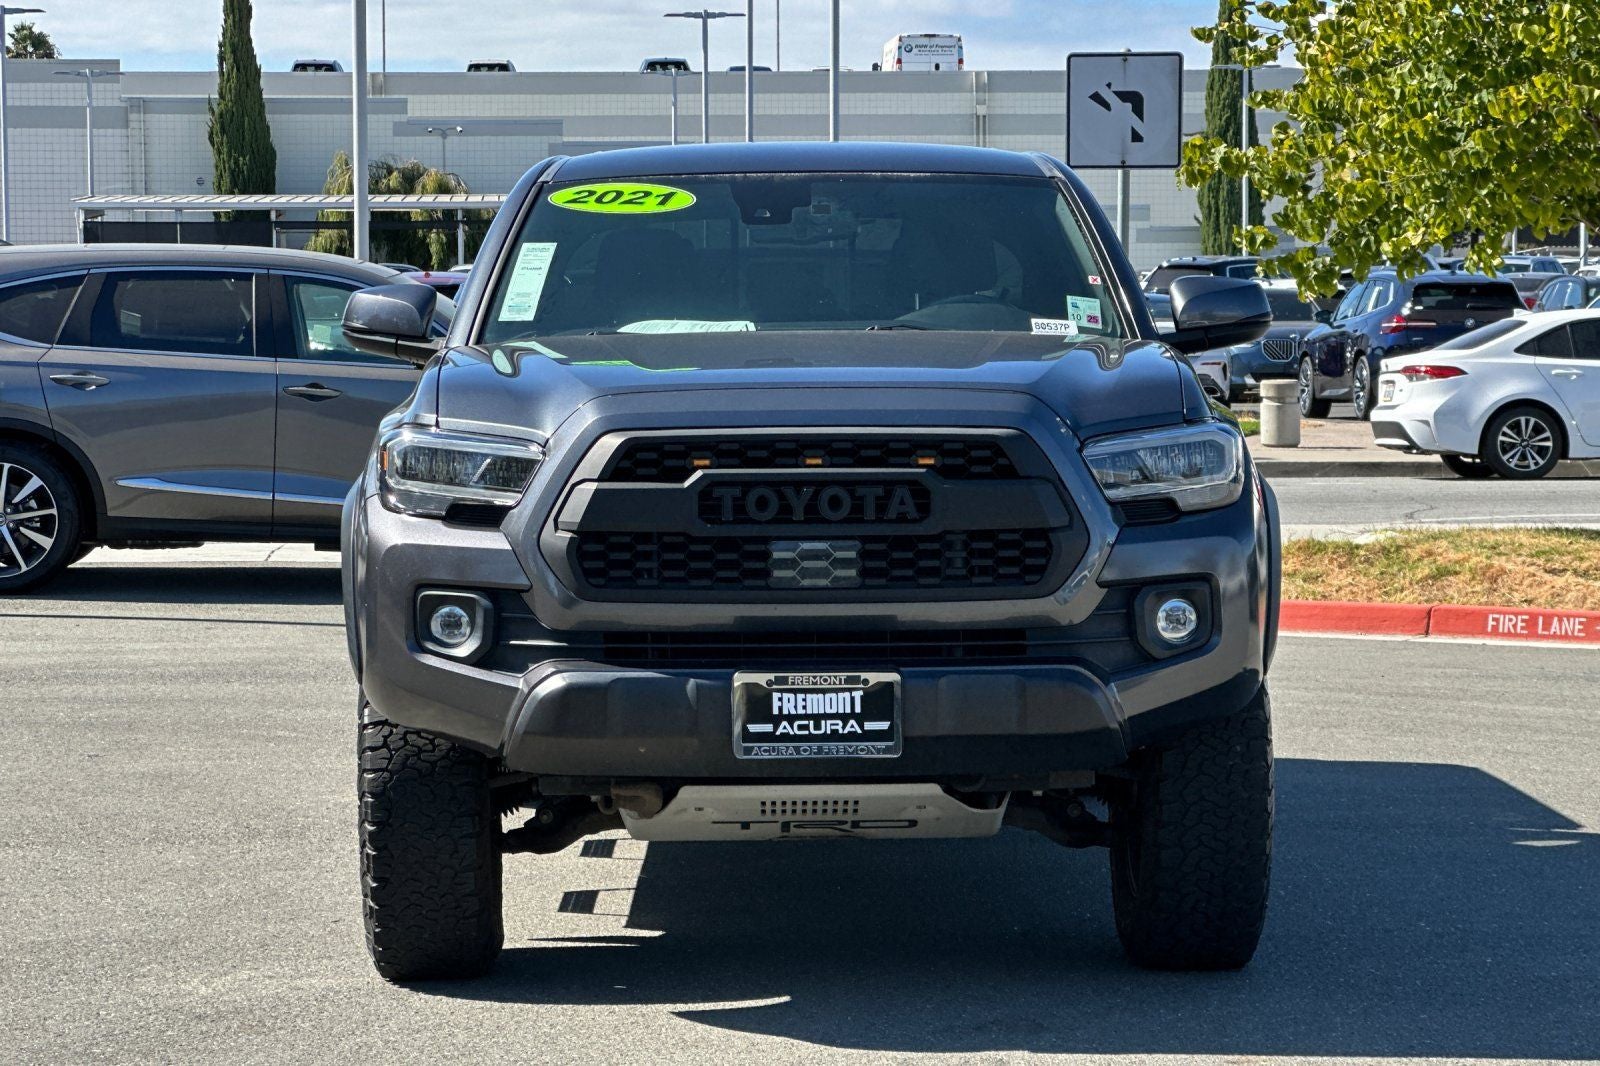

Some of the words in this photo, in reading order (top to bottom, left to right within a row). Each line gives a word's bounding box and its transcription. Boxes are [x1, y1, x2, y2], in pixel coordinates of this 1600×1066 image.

[562, 190, 678, 206] 2021
[1072, 313, 1082, 321] 10
[1087, 315, 1099, 324] 25
[1034, 322, 1070, 331] 80537P
[712, 485, 919, 522] TOYOTA
[1488, 614, 1529, 633] FIRE
[1538, 616, 1586, 636] LANE
[788, 675, 847, 685] FREMONT
[775, 719, 863, 736] ACURA
[751, 746, 797, 756] ACURA
[800, 745, 818, 755] OF
[822, 745, 886, 755] FREMONT
